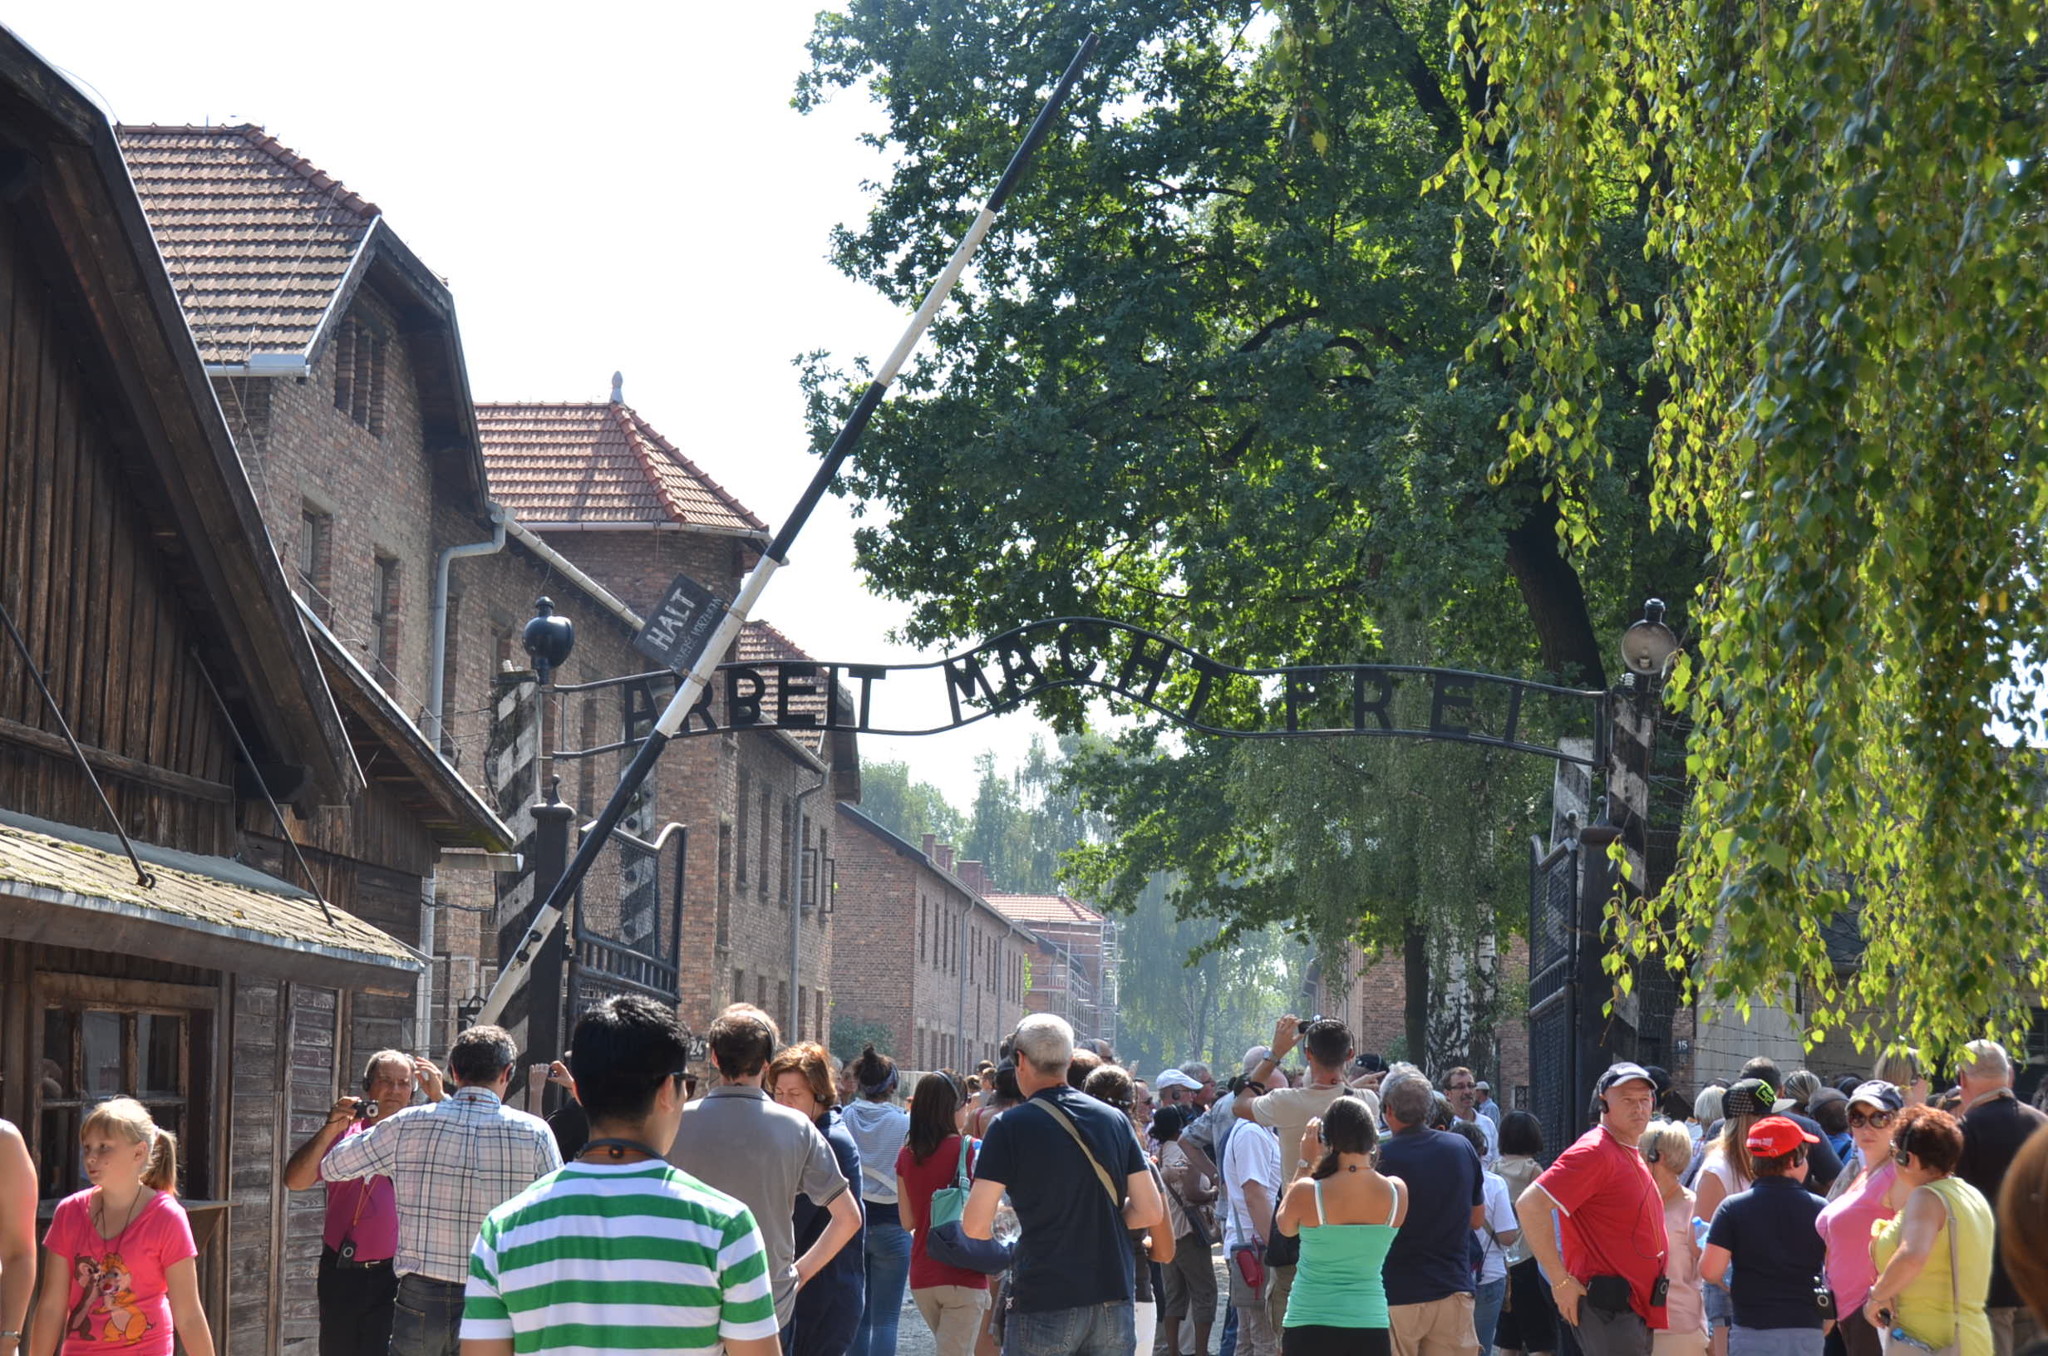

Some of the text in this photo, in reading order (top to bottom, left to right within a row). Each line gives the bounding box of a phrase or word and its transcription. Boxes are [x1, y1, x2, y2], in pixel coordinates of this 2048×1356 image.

[646, 587, 696, 651] HALT
[624, 620, 1522, 742] ARBEIT MACHT FREI
[689, 1039, 704, 1056] 24
[1677, 1039, 1688, 1050] 15
